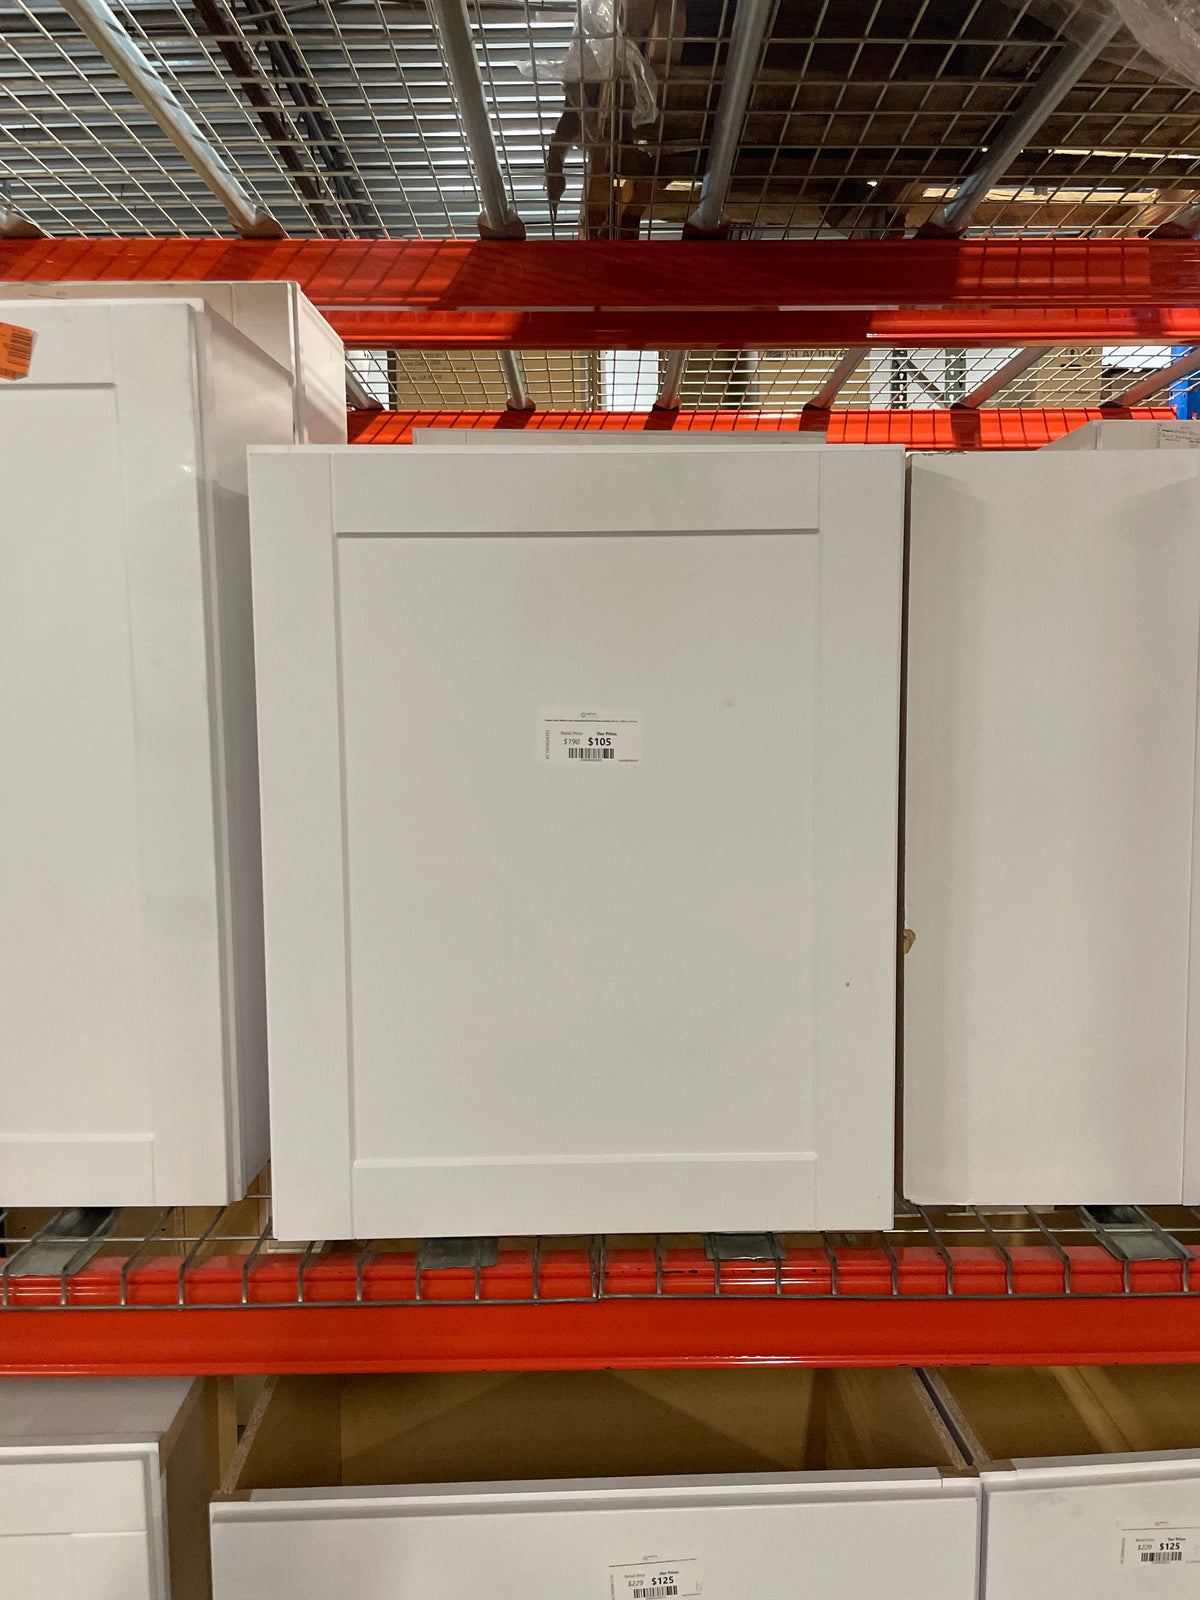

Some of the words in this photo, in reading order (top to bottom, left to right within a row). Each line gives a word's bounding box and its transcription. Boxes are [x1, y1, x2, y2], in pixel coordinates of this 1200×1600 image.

[563, 738, 581, 746] $190
[587, 737, 612, 747] $105
[1137, 1543, 1153, 1551] $229
[1159, 1542, 1181, 1551] $125
[628, 1579, 644, 1587] $229
[651, 1576, 674, 1586] $125
